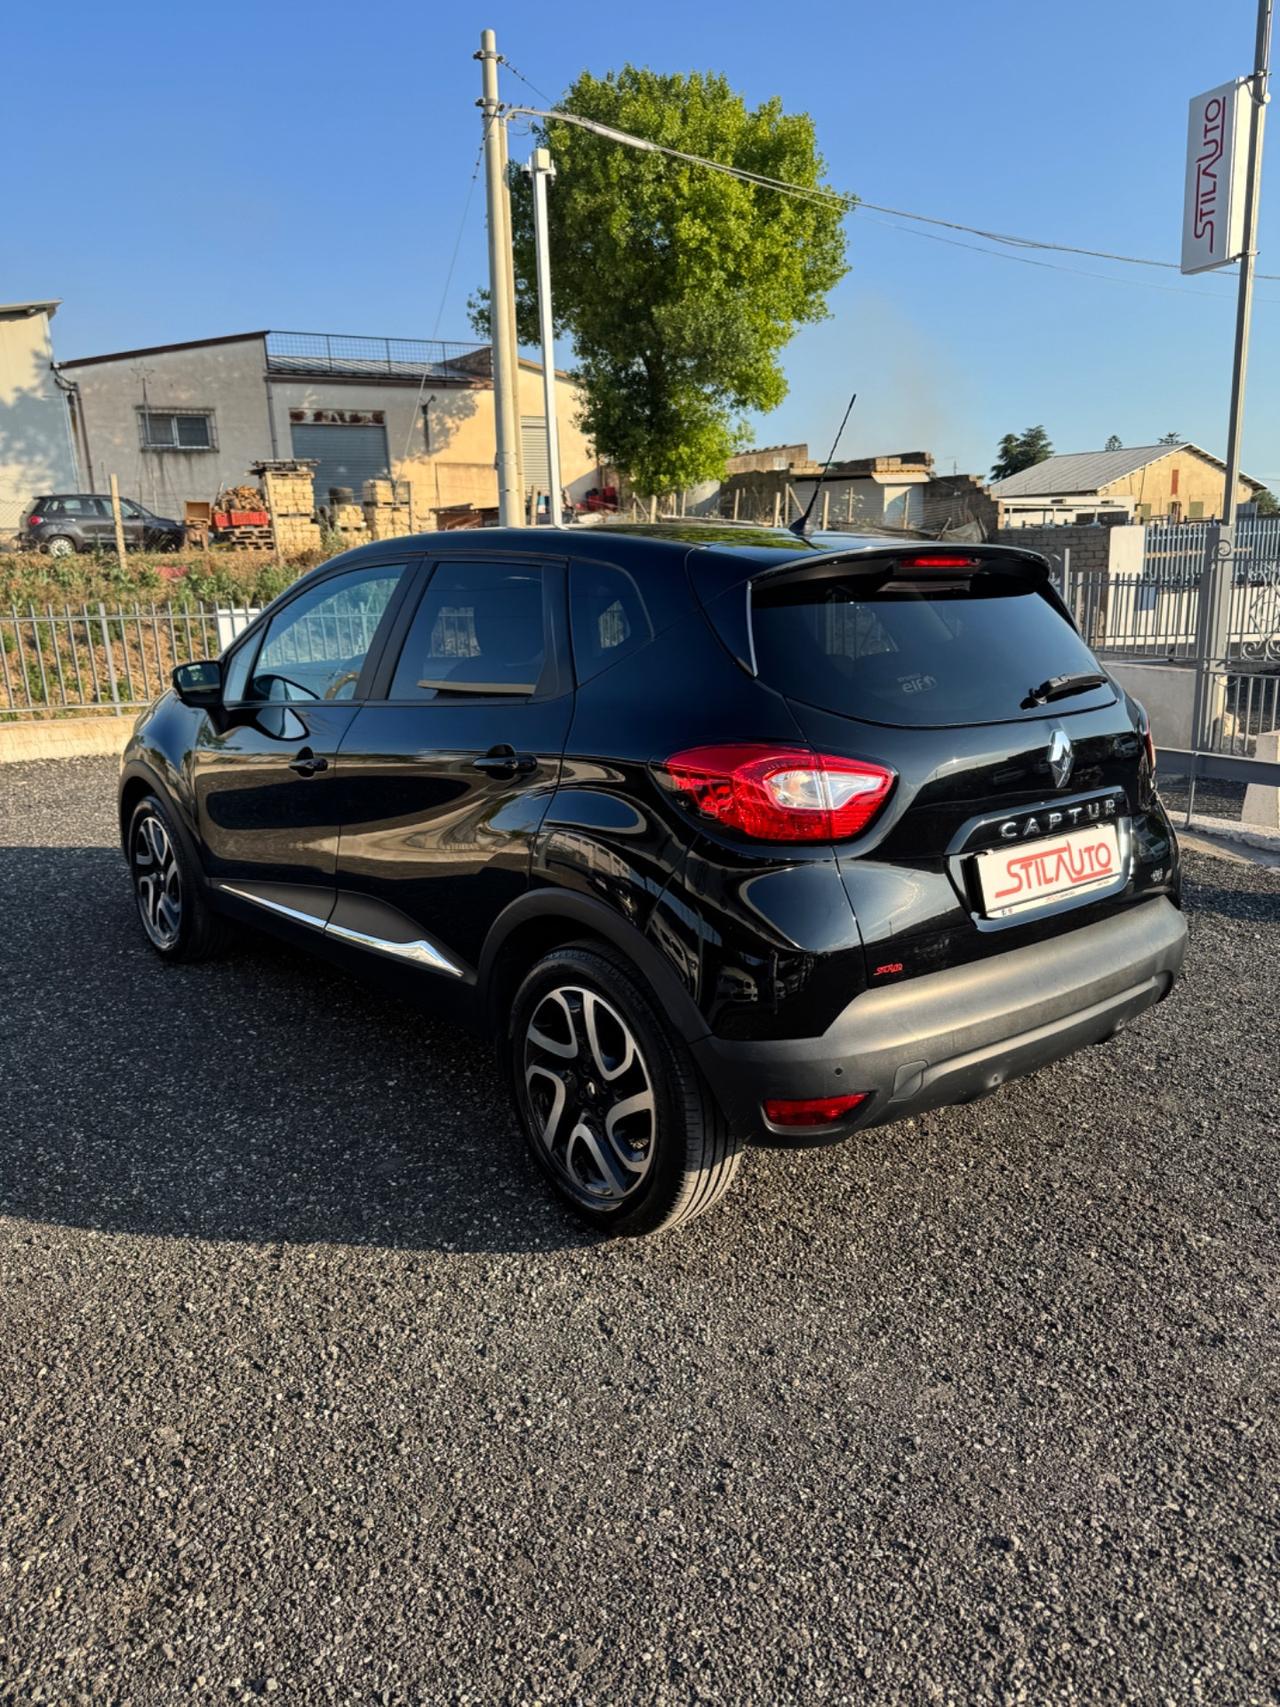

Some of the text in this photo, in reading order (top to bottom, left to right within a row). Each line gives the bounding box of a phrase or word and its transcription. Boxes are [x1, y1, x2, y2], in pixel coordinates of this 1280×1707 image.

[1194, 97, 1226, 253] STILAUTO
[1001, 799, 1116, 837] CAPTUR
[995, 840, 1113, 898] STILAUTO
